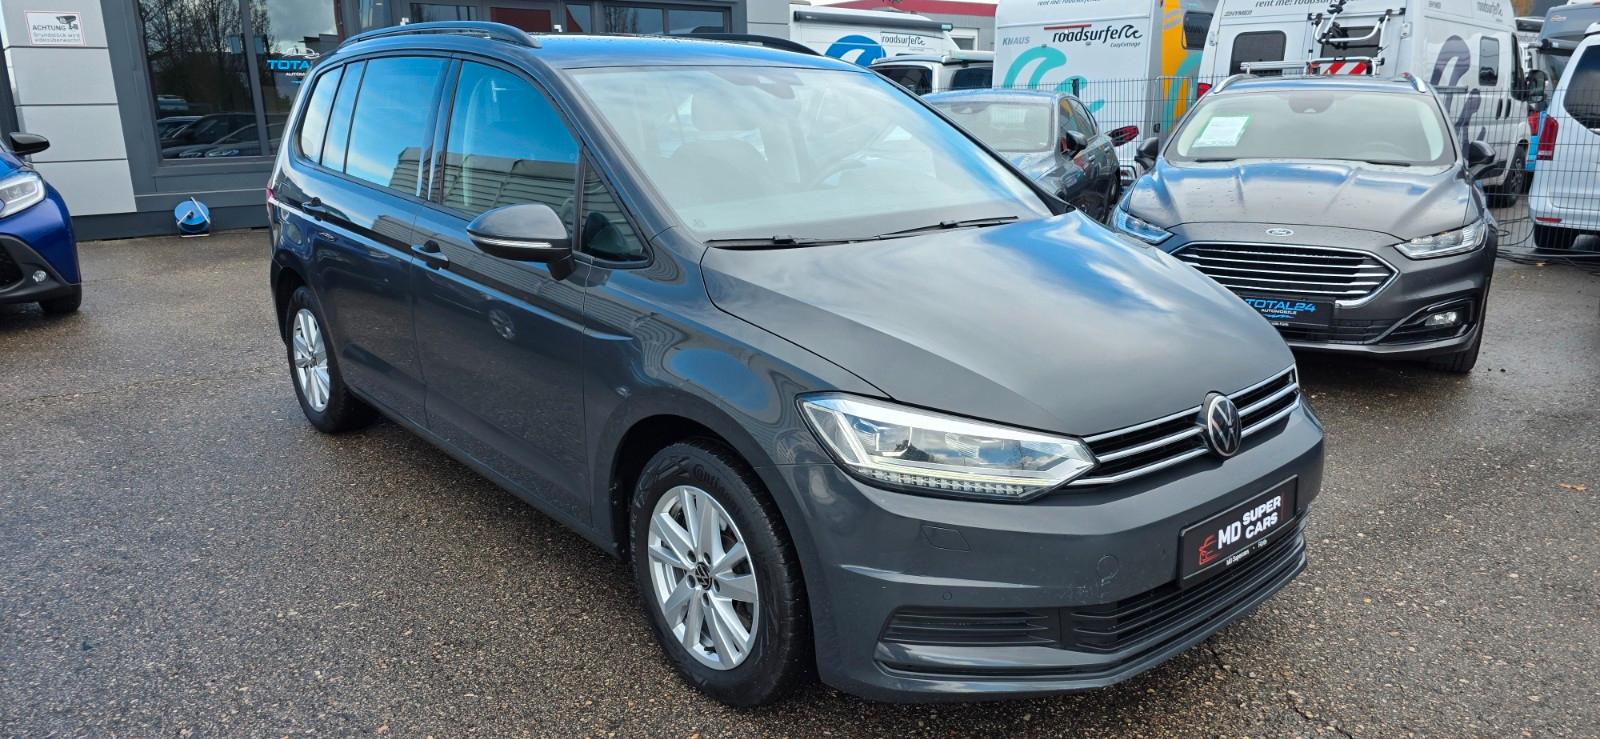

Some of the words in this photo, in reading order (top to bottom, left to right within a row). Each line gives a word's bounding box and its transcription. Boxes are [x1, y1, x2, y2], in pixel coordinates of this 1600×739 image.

[1255, 0, 1274, 8] rent
[1002, 36, 1031, 46] KNAUS
[1052, 24, 1143, 44] roadsurfer
[266, 59, 310, 70] TOTA
[1245, 298, 1317, 313] TOTAL24
[1218, 520, 1241, 550] MD
[1242, 495, 1281, 526] SUPER
[1245, 511, 1278, 539] CARS
